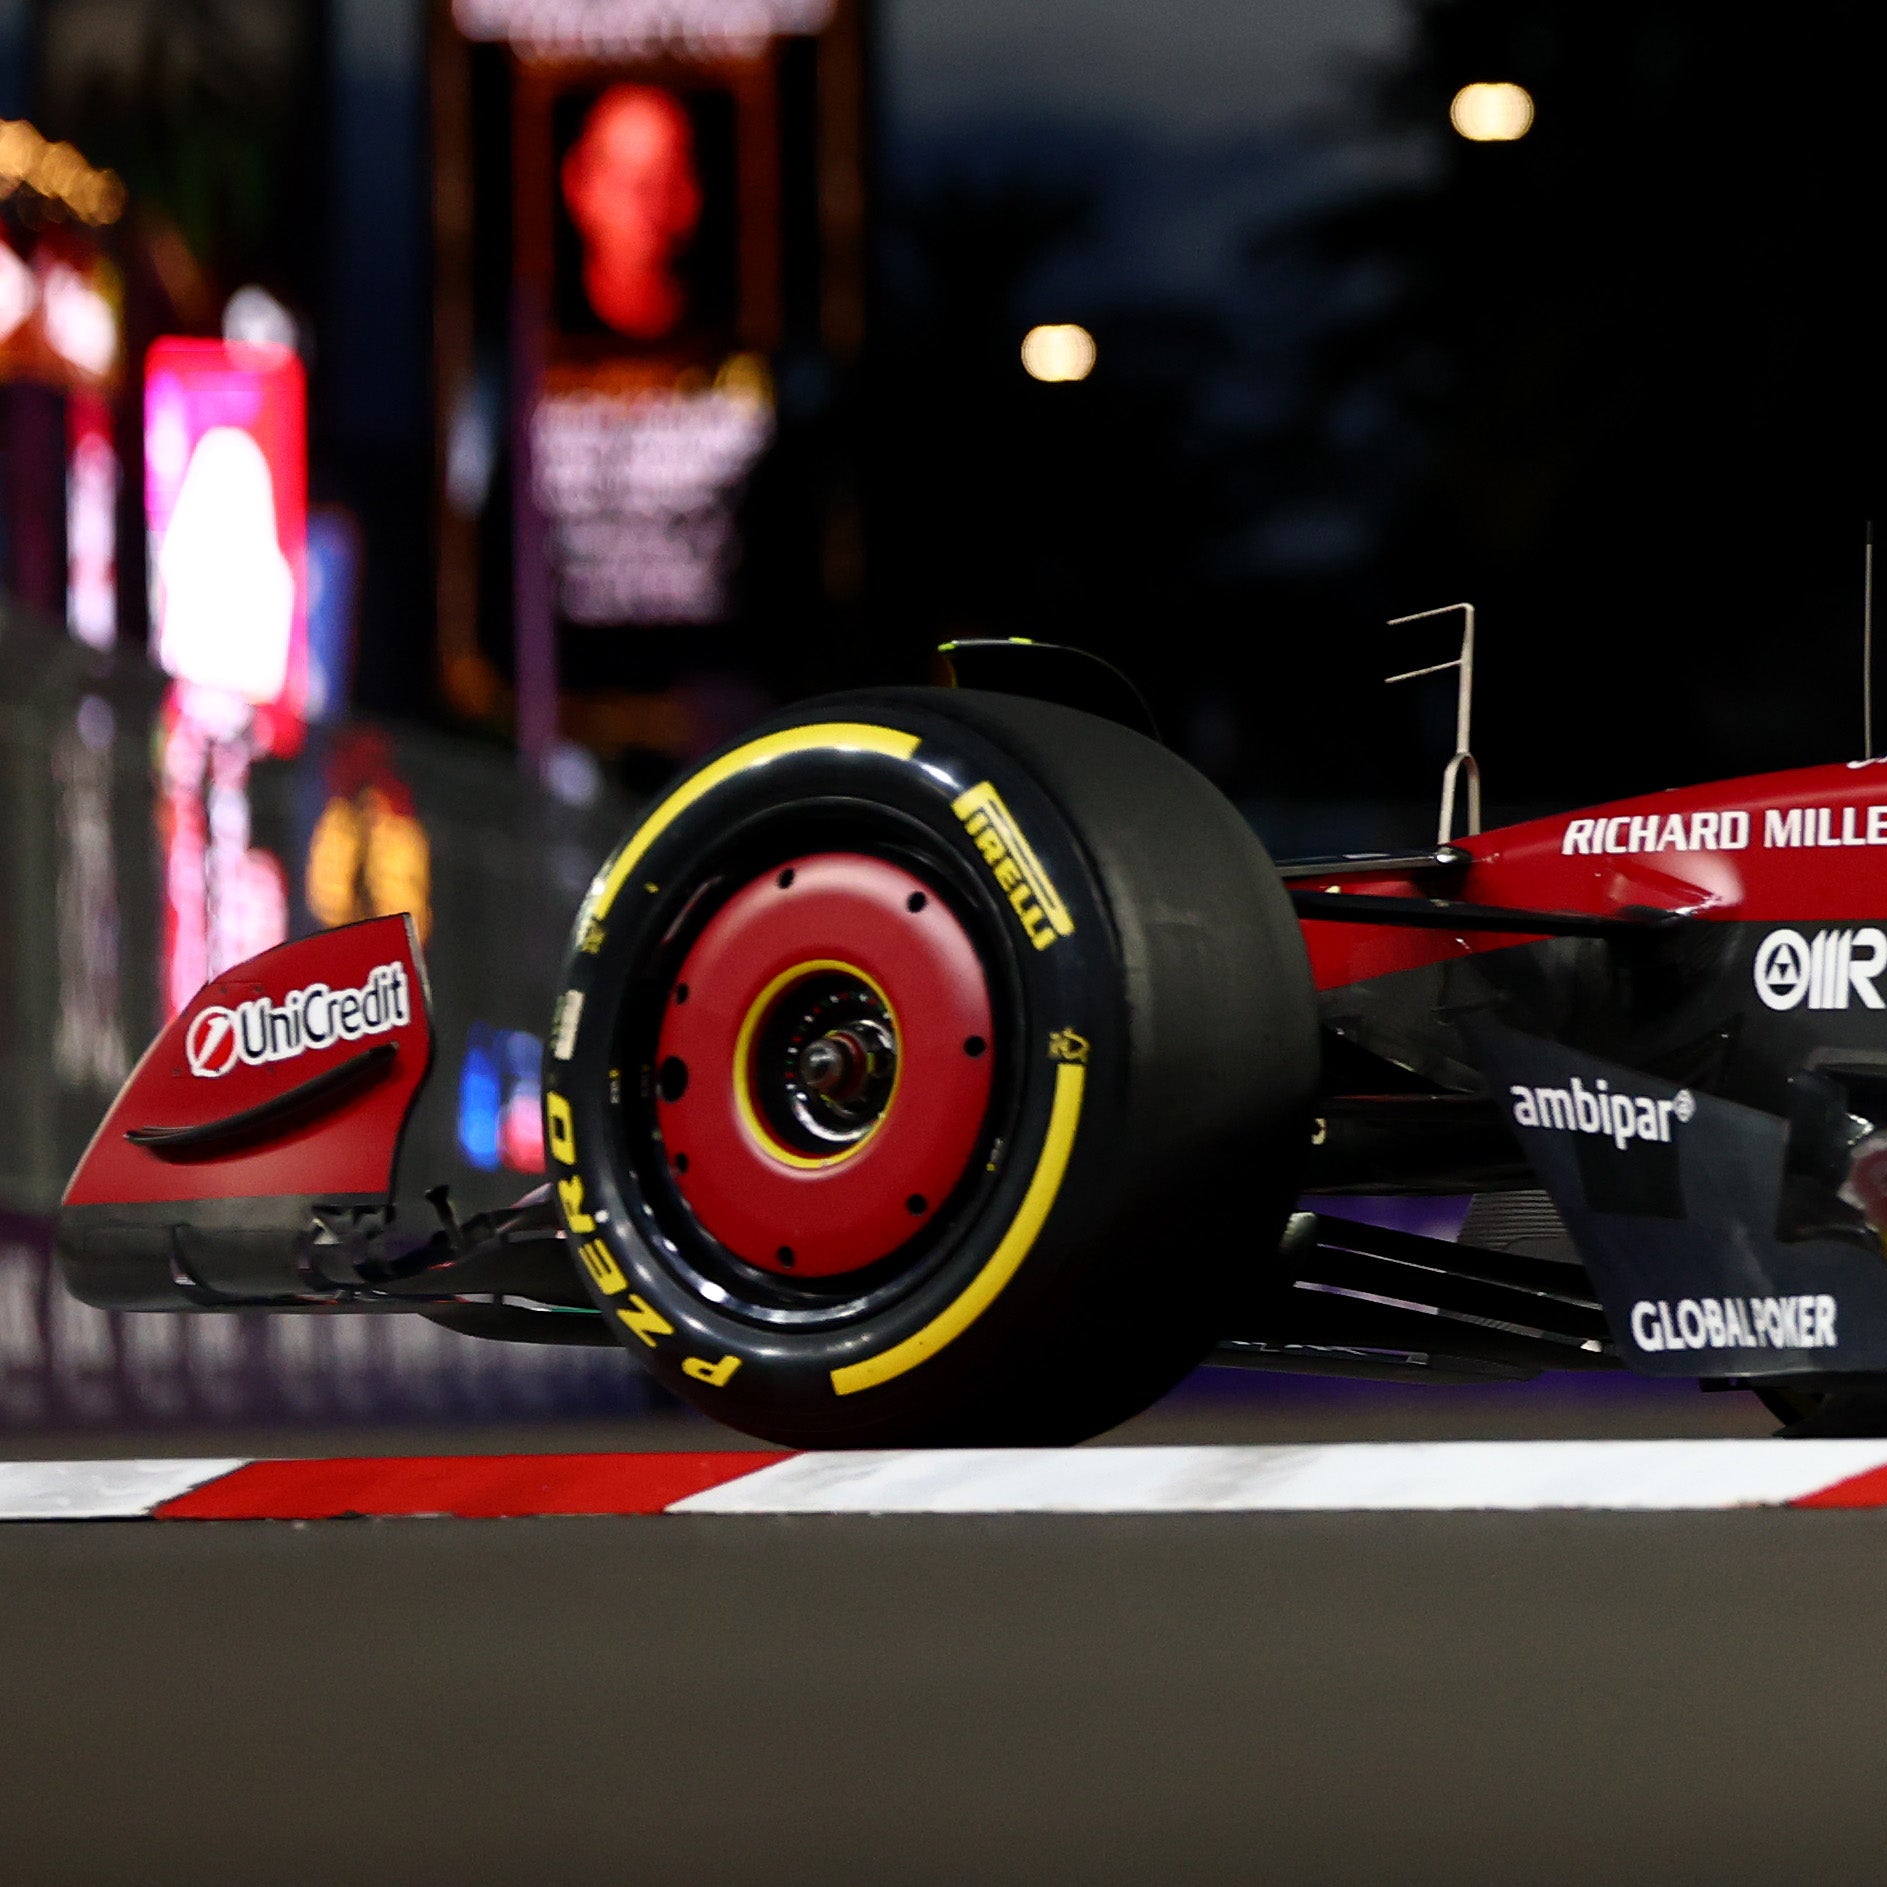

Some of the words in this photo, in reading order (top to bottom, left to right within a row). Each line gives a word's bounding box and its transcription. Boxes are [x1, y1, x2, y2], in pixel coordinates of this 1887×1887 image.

[950, 780, 1076, 951] PIRELLI
[1562, 809, 1750, 855] RICHARD
[239, 964, 407, 1062] UniCredit
[546, 1090, 675, 1349] ZERO
[1631, 1297, 1757, 1354] GLOBAL
[1750, 1294, 1838, 1349] POKER
[681, 1354, 742, 1388] P
